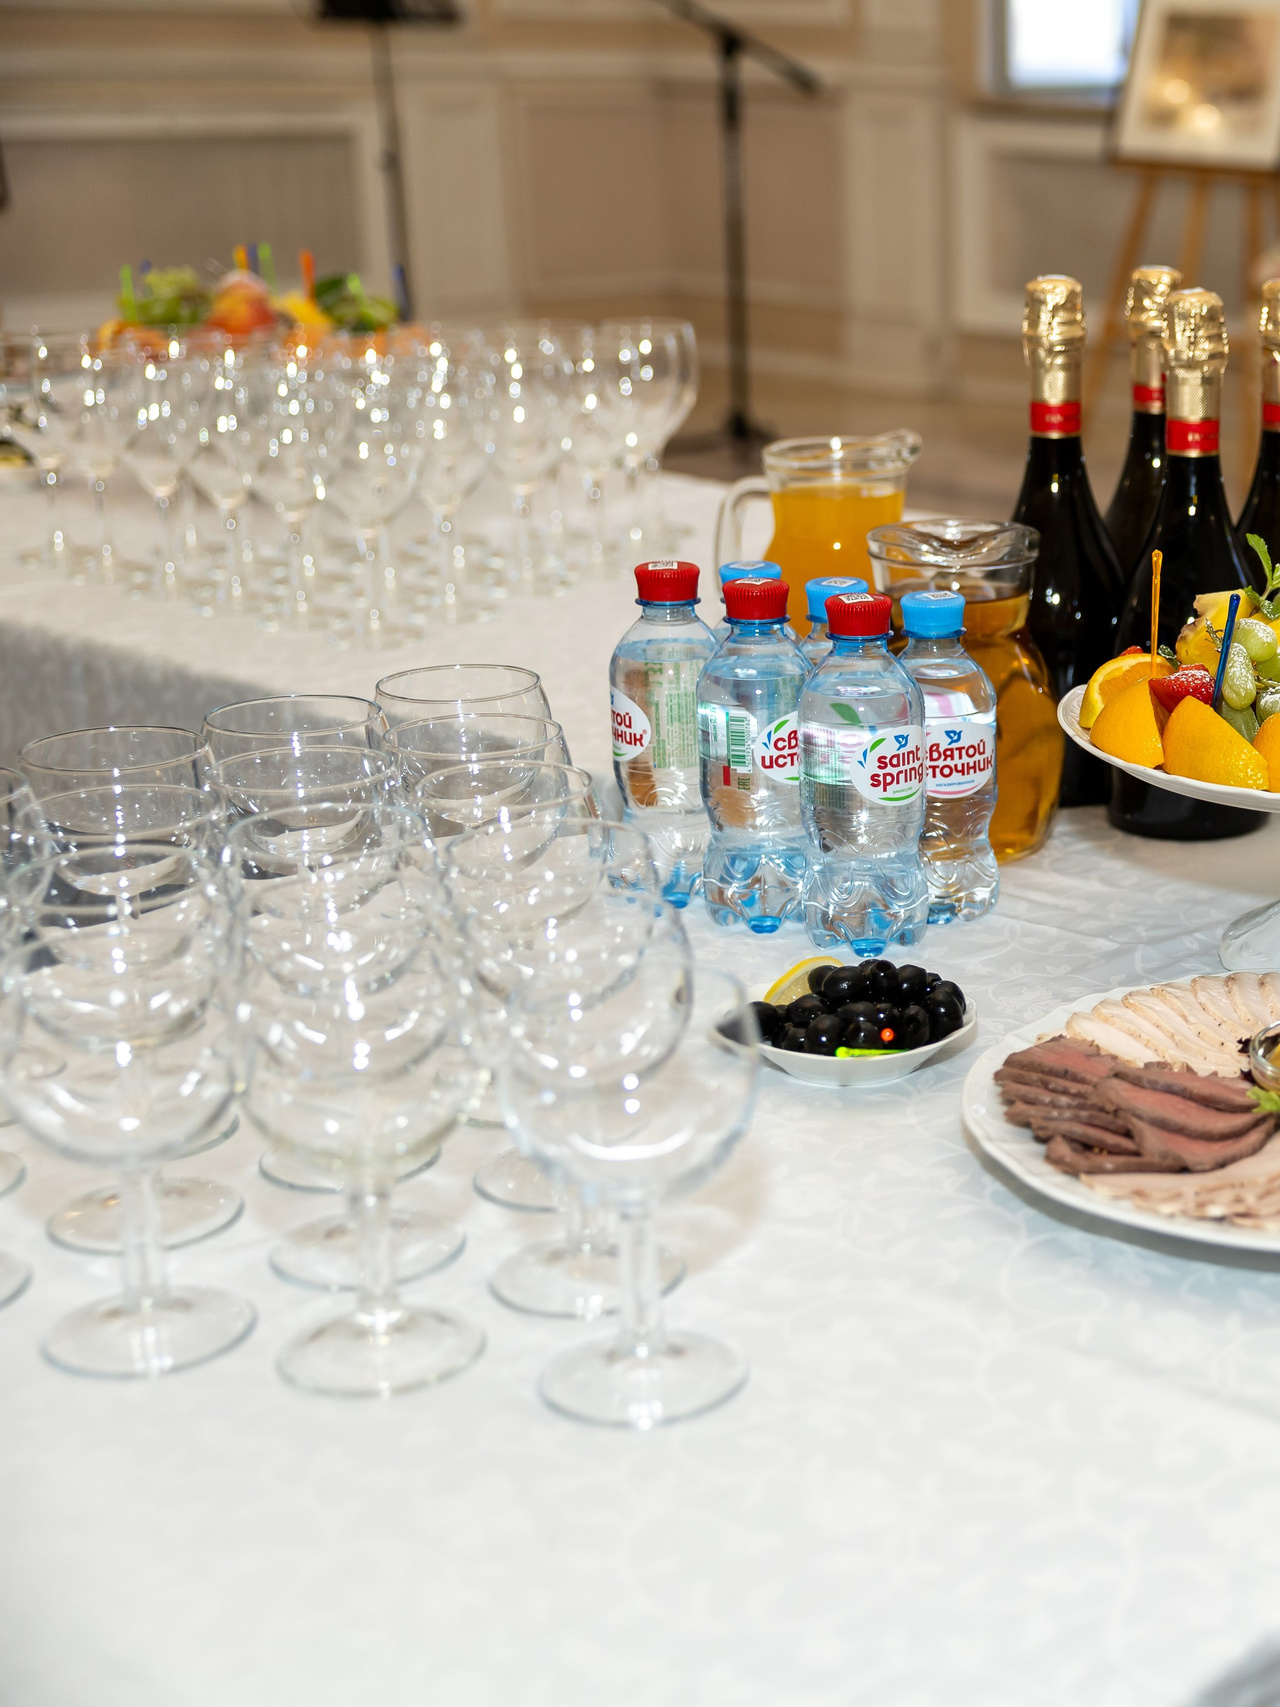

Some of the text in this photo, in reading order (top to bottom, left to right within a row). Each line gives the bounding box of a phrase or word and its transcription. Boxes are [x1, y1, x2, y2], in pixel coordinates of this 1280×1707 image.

[877, 744, 921, 770] saint
[926, 738, 986, 762] вятой
[870, 762, 924, 792] spring
